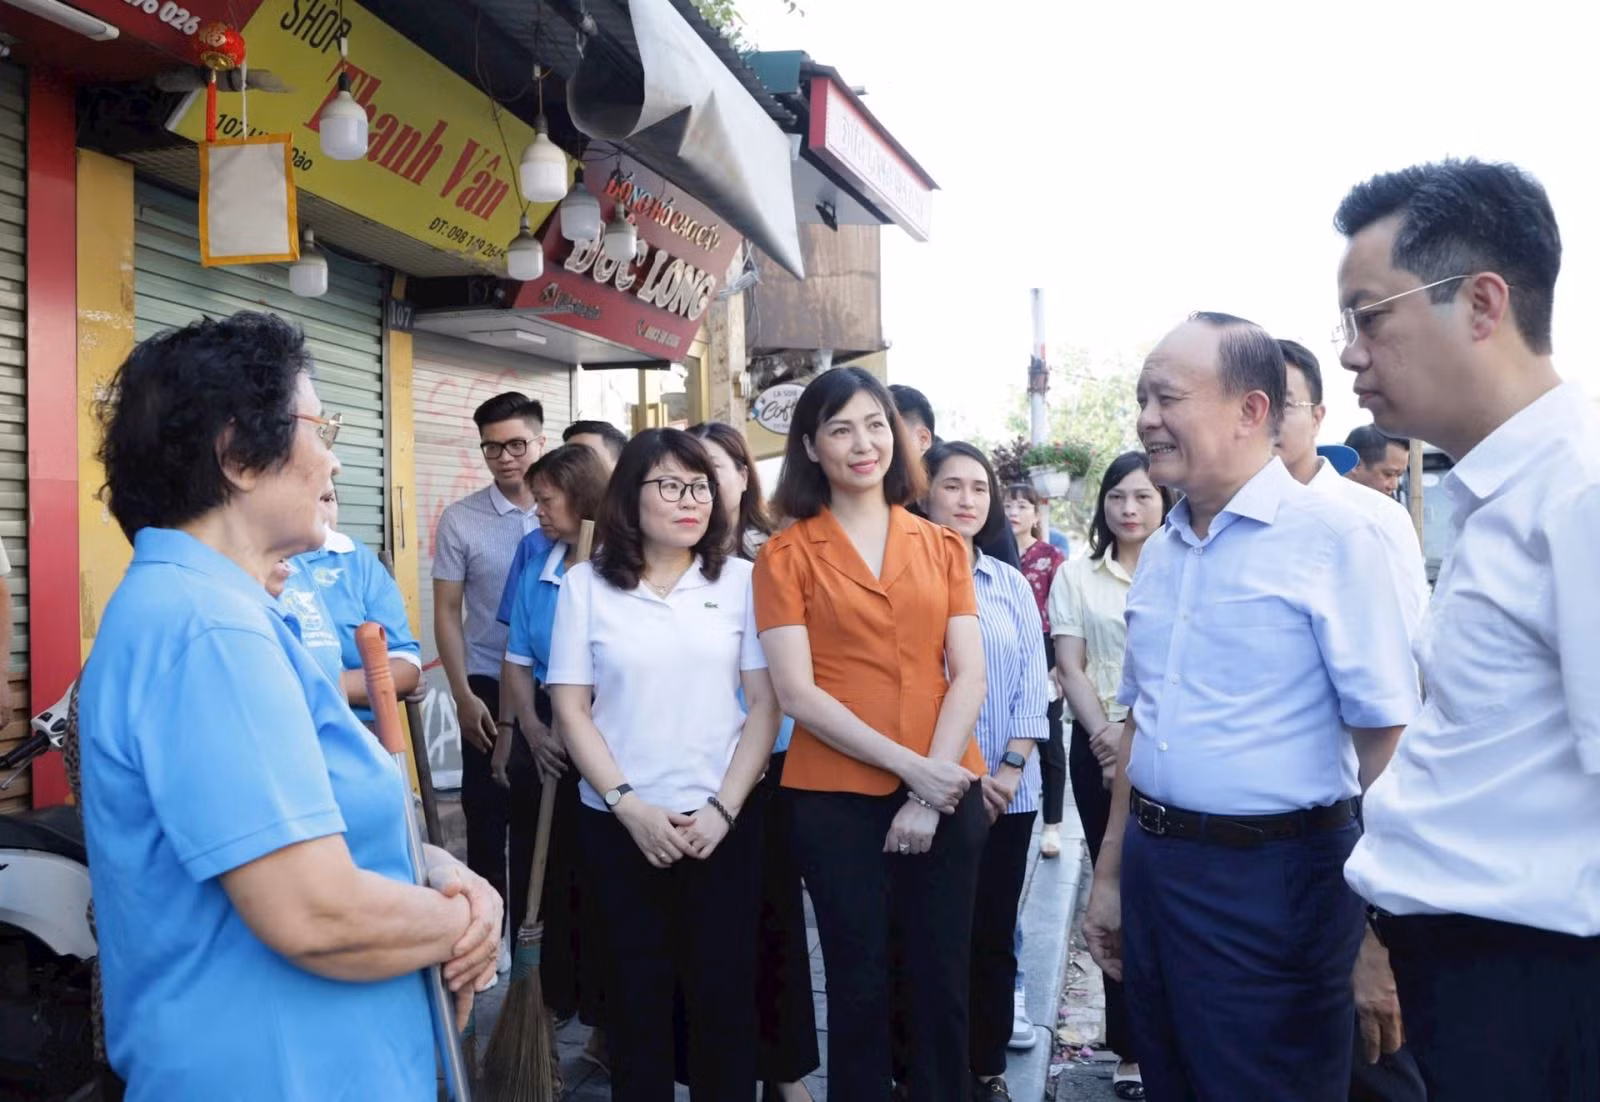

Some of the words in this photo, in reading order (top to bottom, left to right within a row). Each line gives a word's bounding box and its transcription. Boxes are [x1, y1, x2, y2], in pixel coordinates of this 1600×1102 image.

[159, 1, 201, 35] 026
[280, 0, 352, 54] SHOP
[303, 60, 449, 186] Thanh
[438, 137, 510, 220] Vân
[447, 225, 469, 244] 098
[637, 249, 717, 321] LONG
[391, 301, 411, 328] 107
